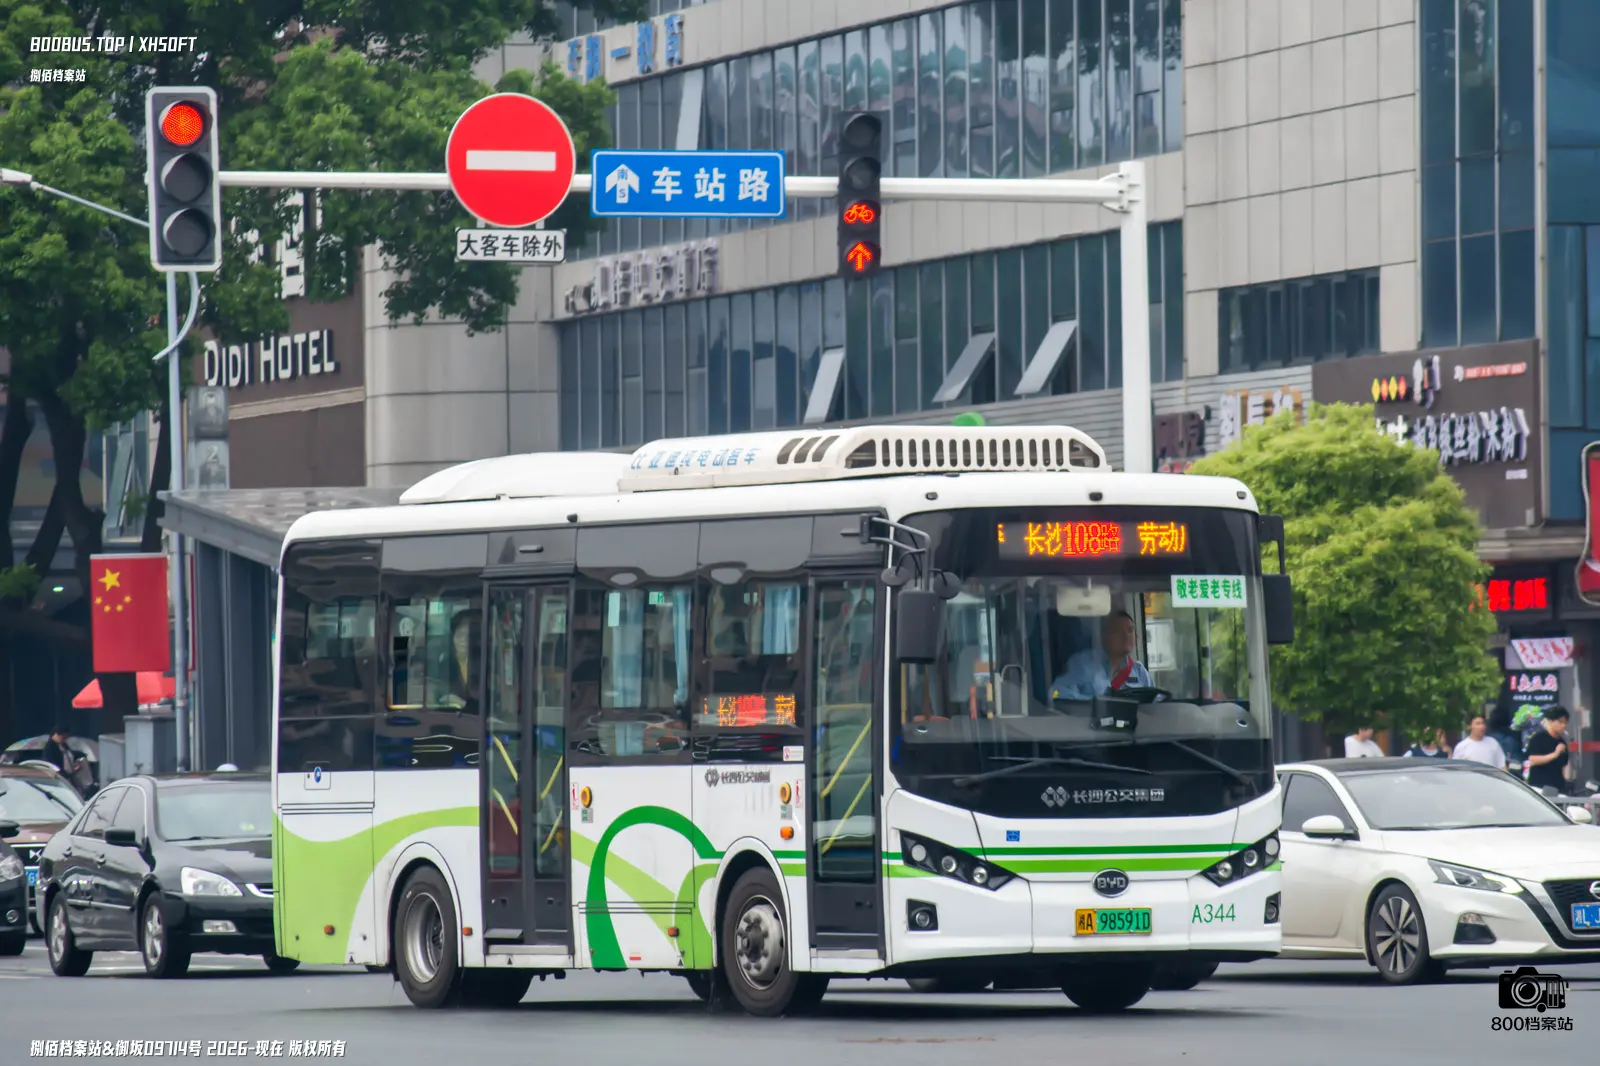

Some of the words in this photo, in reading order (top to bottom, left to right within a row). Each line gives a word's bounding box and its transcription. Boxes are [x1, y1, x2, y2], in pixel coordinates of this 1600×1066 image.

[619, 188, 626, 198] S
[651, 167, 770, 202] 车站路
[459, 233, 562, 258] 大客车除外
[204, 340, 249, 387] DIDI
[260, 329, 336, 382] HOTEL
[1024, 521, 1121, 556] 长沙108路
[1175, 578, 1243, 600] 敬老爱老专线
[1097, 877, 1126, 889] BYD
[1099, 911, 1151, 931] 98591D
[1191, 903, 1236, 924] A344
